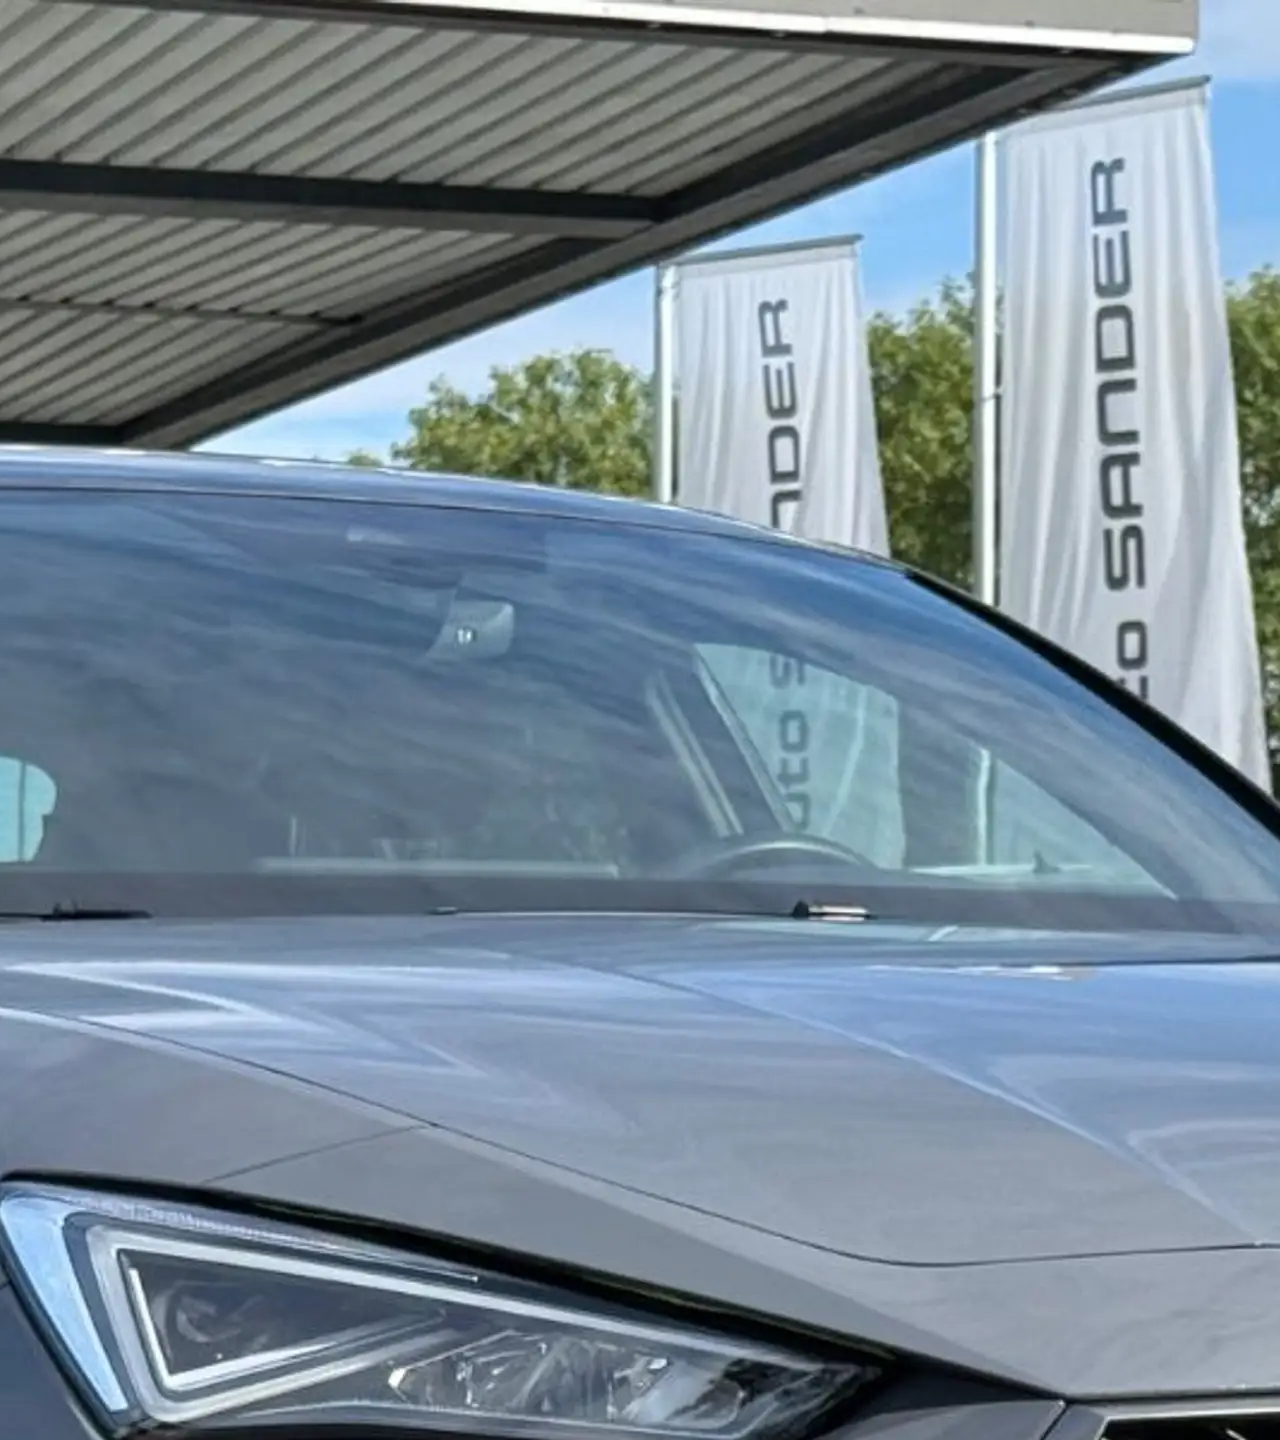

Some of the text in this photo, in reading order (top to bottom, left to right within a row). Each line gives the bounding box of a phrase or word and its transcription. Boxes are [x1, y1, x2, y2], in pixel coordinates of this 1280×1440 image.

[757, 298, 803, 530] NDER
[1090, 157, 1147, 591] SANDER
[776, 709, 811, 833] uto
